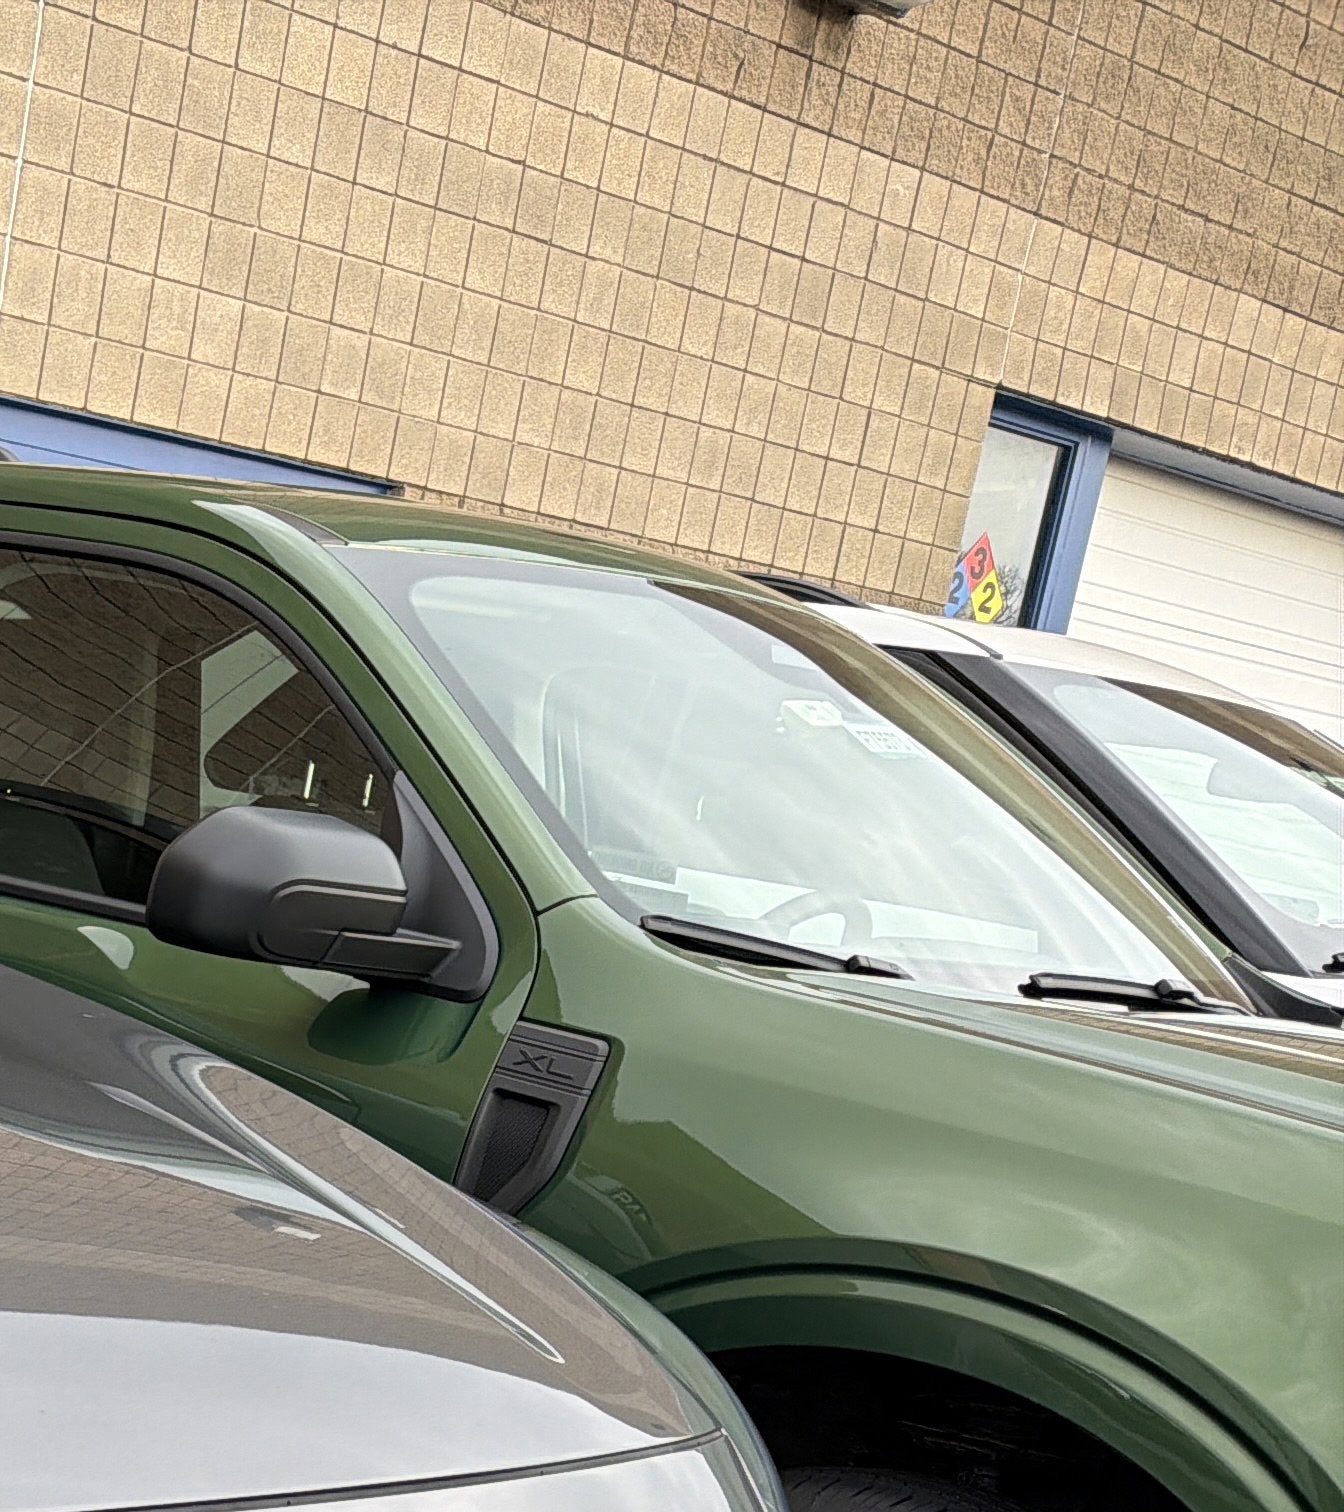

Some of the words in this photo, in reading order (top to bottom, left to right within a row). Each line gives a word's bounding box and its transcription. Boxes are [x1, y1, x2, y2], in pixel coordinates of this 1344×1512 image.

[970, 546, 988, 580] 3
[948, 571, 965, 604] 2
[978, 581, 997, 614] 2
[511, 1046, 574, 1081] XL
